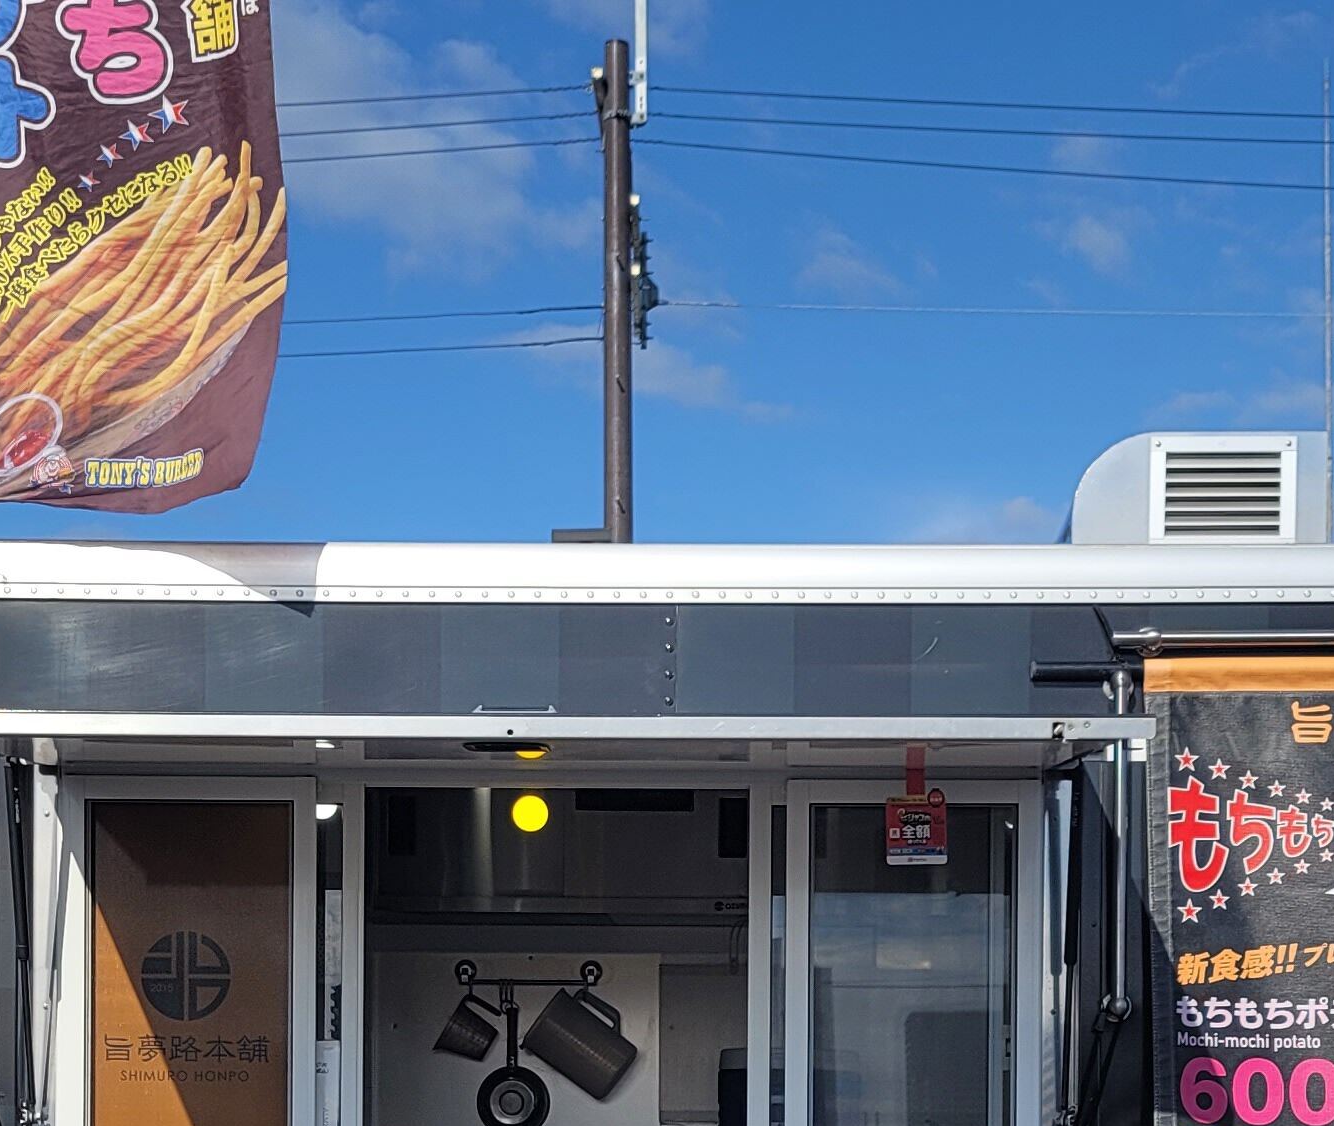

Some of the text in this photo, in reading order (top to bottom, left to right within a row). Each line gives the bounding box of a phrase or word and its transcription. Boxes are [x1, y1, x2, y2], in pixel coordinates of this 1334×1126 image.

[85, 457, 149, 488] TONY'S
[1169, 776, 1334, 892] もちもち
[105, 1034, 271, 1063] 旨夢路本舗
[1177, 1032, 1321, 1050] Mochi-mochi potato
[120, 1071, 249, 1083] SHIMURO HONPO
